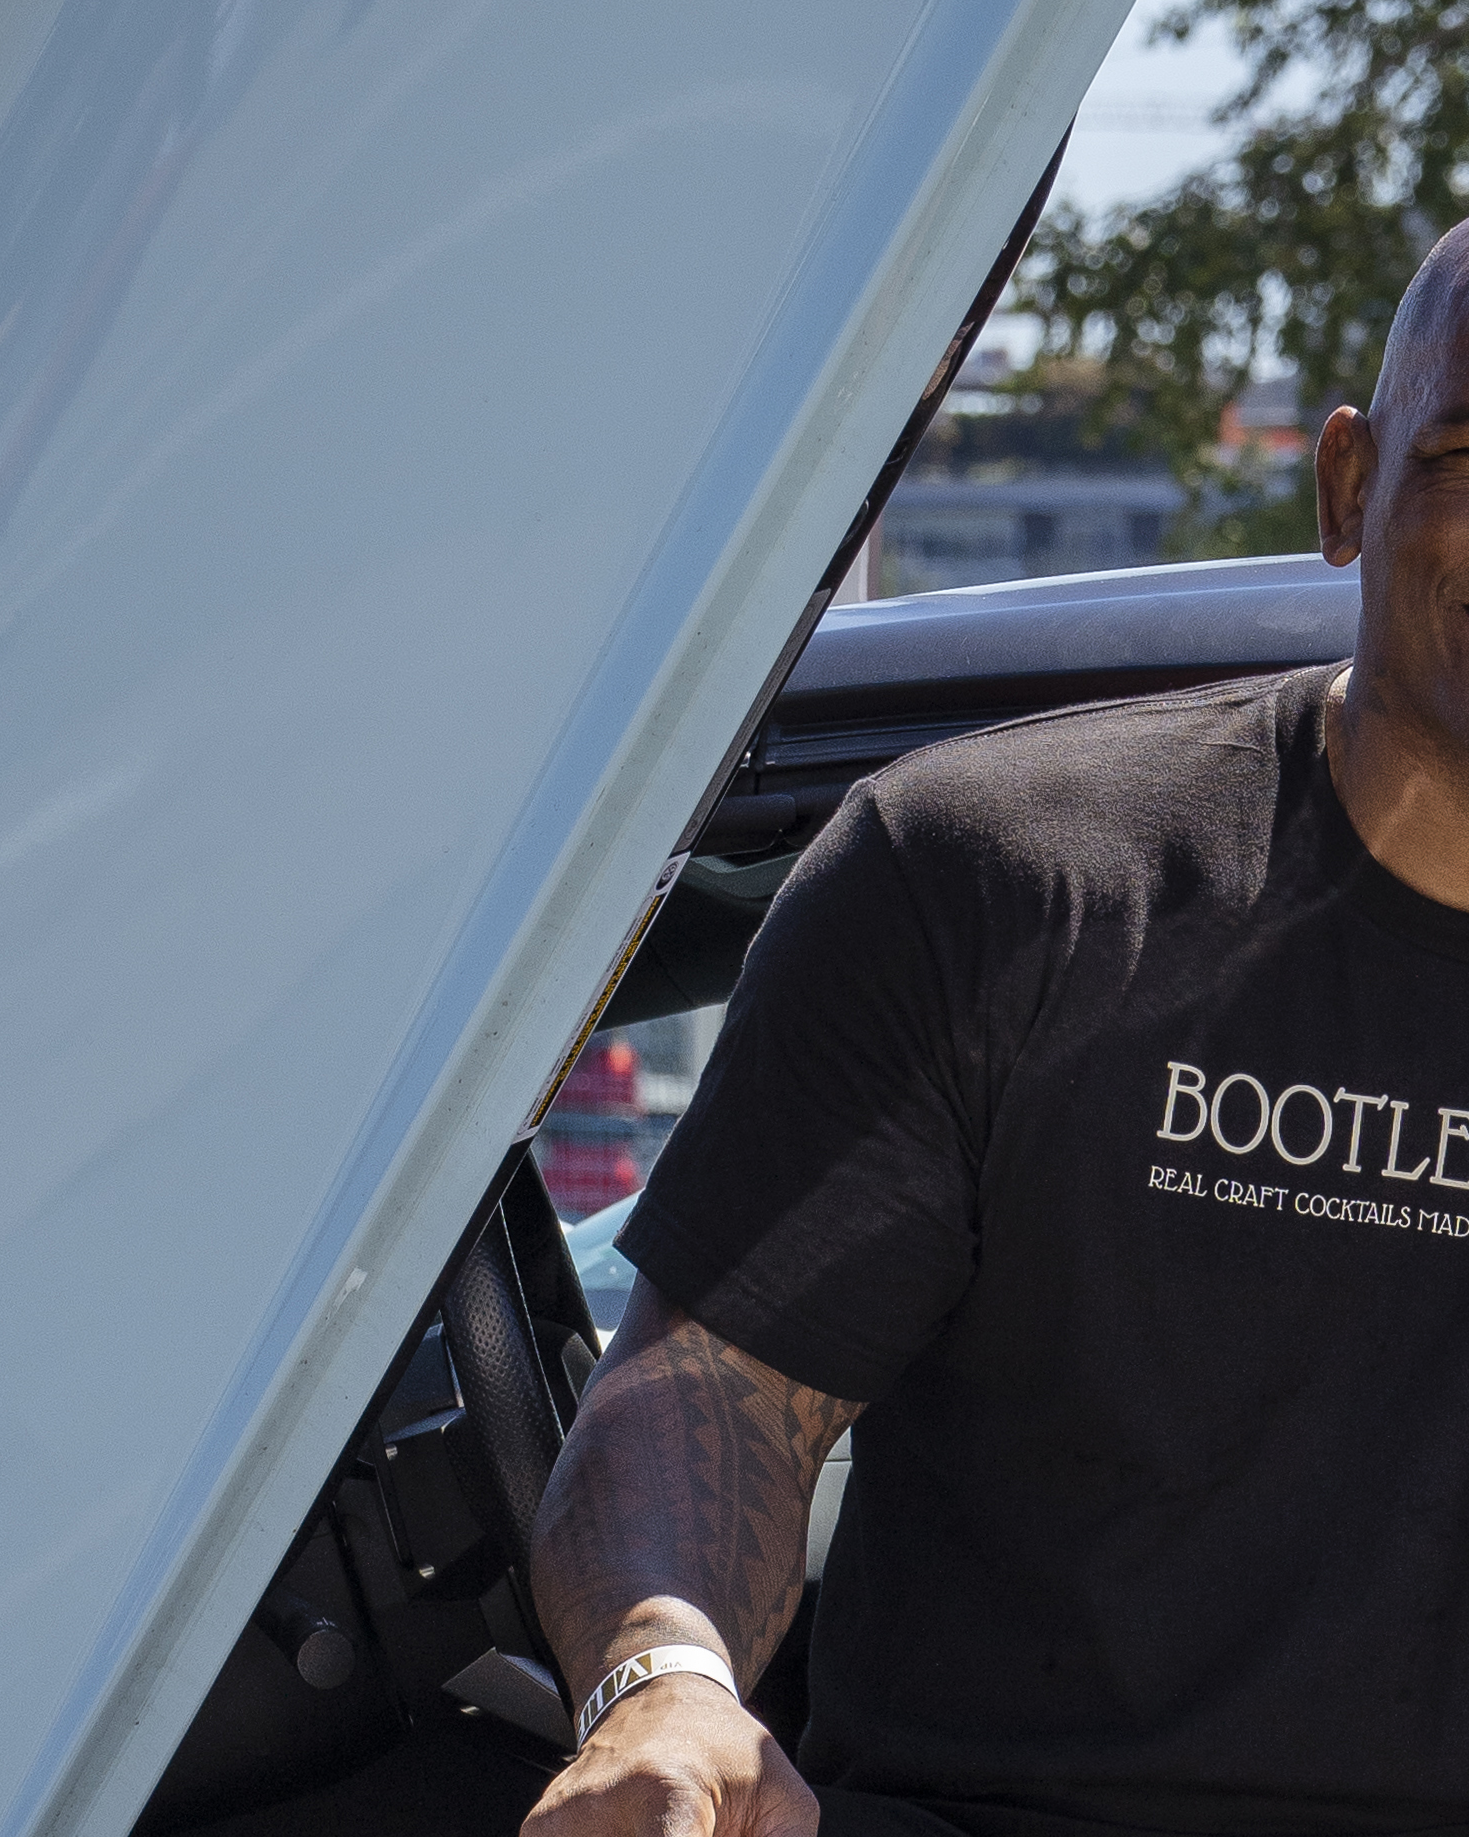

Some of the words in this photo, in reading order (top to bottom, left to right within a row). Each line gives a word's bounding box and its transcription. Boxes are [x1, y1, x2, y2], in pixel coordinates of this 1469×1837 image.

[1148, 1165, 1207, 1197] REAL
[1215, 1179, 1289, 1210] CRAFT
[1295, 1193, 1410, 1228] COCKTAILS
